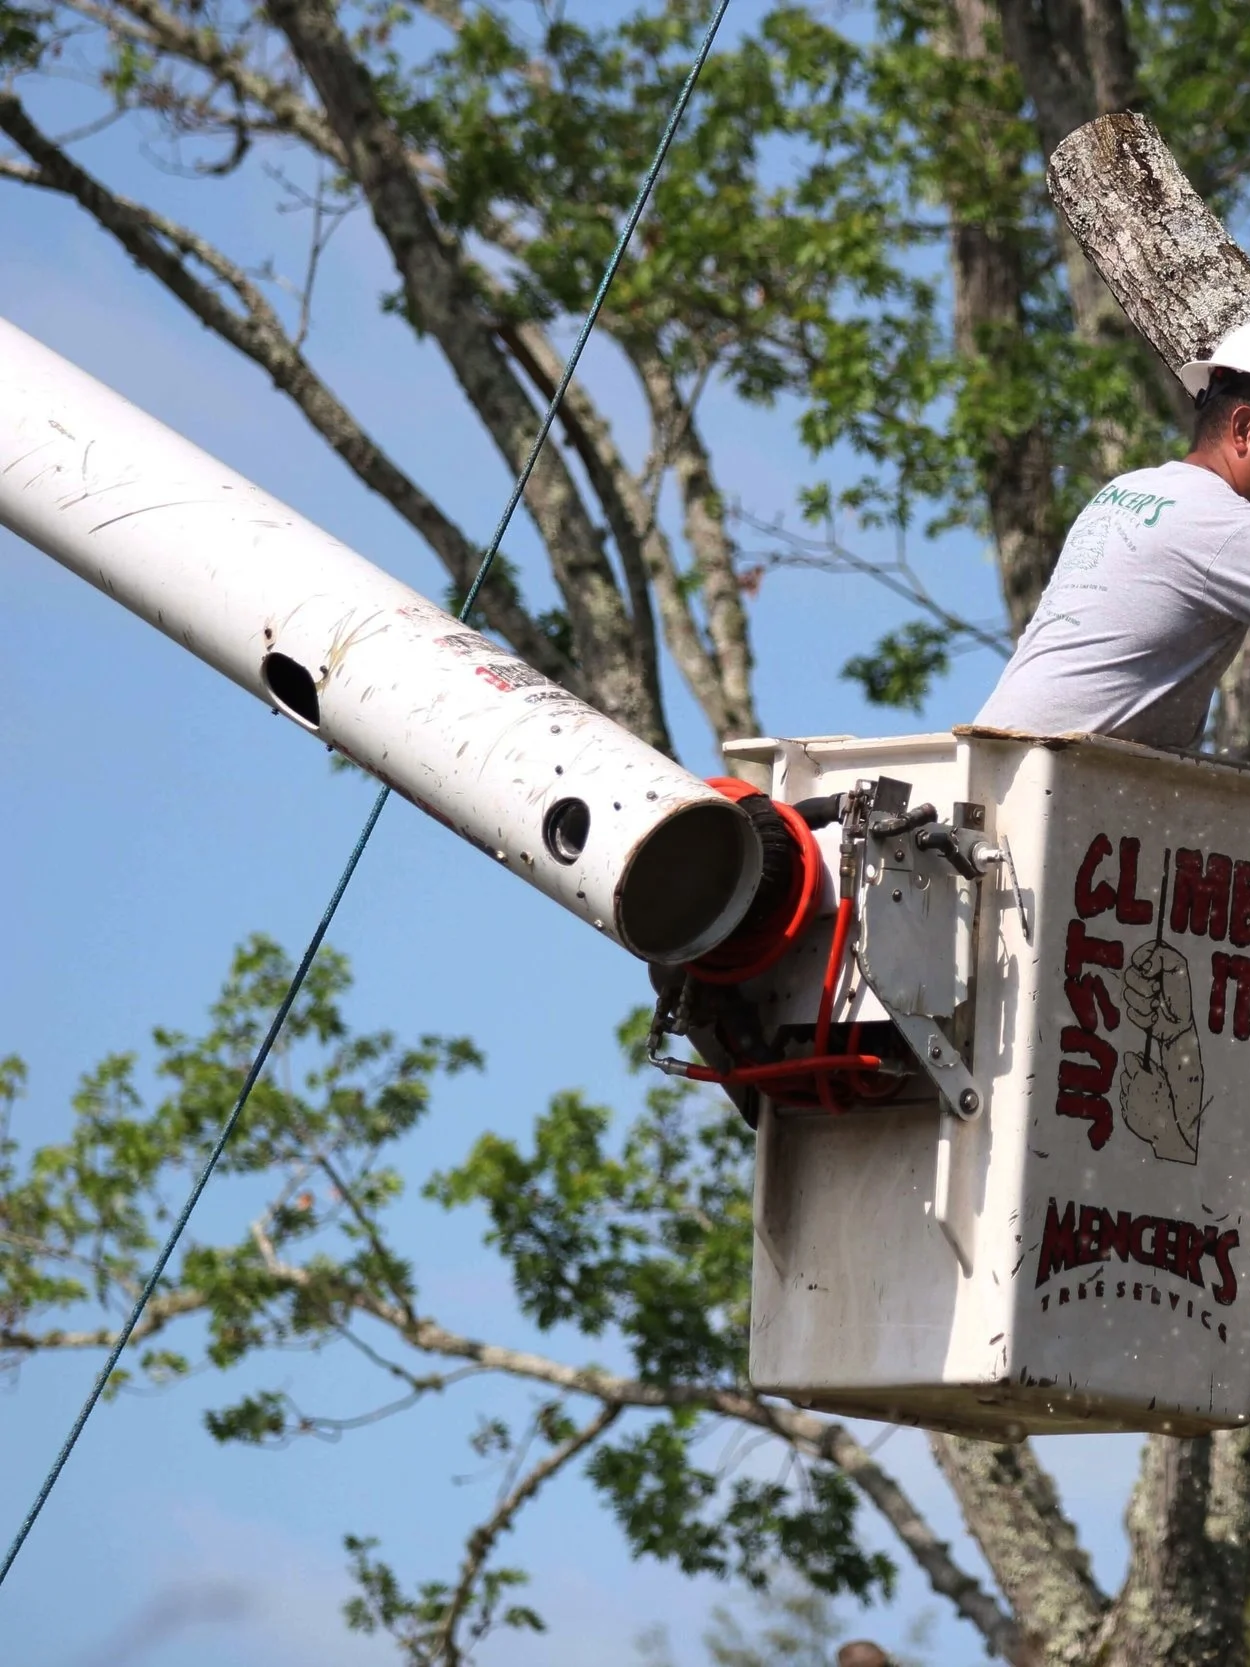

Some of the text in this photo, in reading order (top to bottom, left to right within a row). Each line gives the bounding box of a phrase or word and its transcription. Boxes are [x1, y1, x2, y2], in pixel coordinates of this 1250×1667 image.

[1092, 484, 1177, 527] ENCER'S
[1055, 918, 1124, 1151] JUST
[1041, 1281, 1104, 1312] TREE
